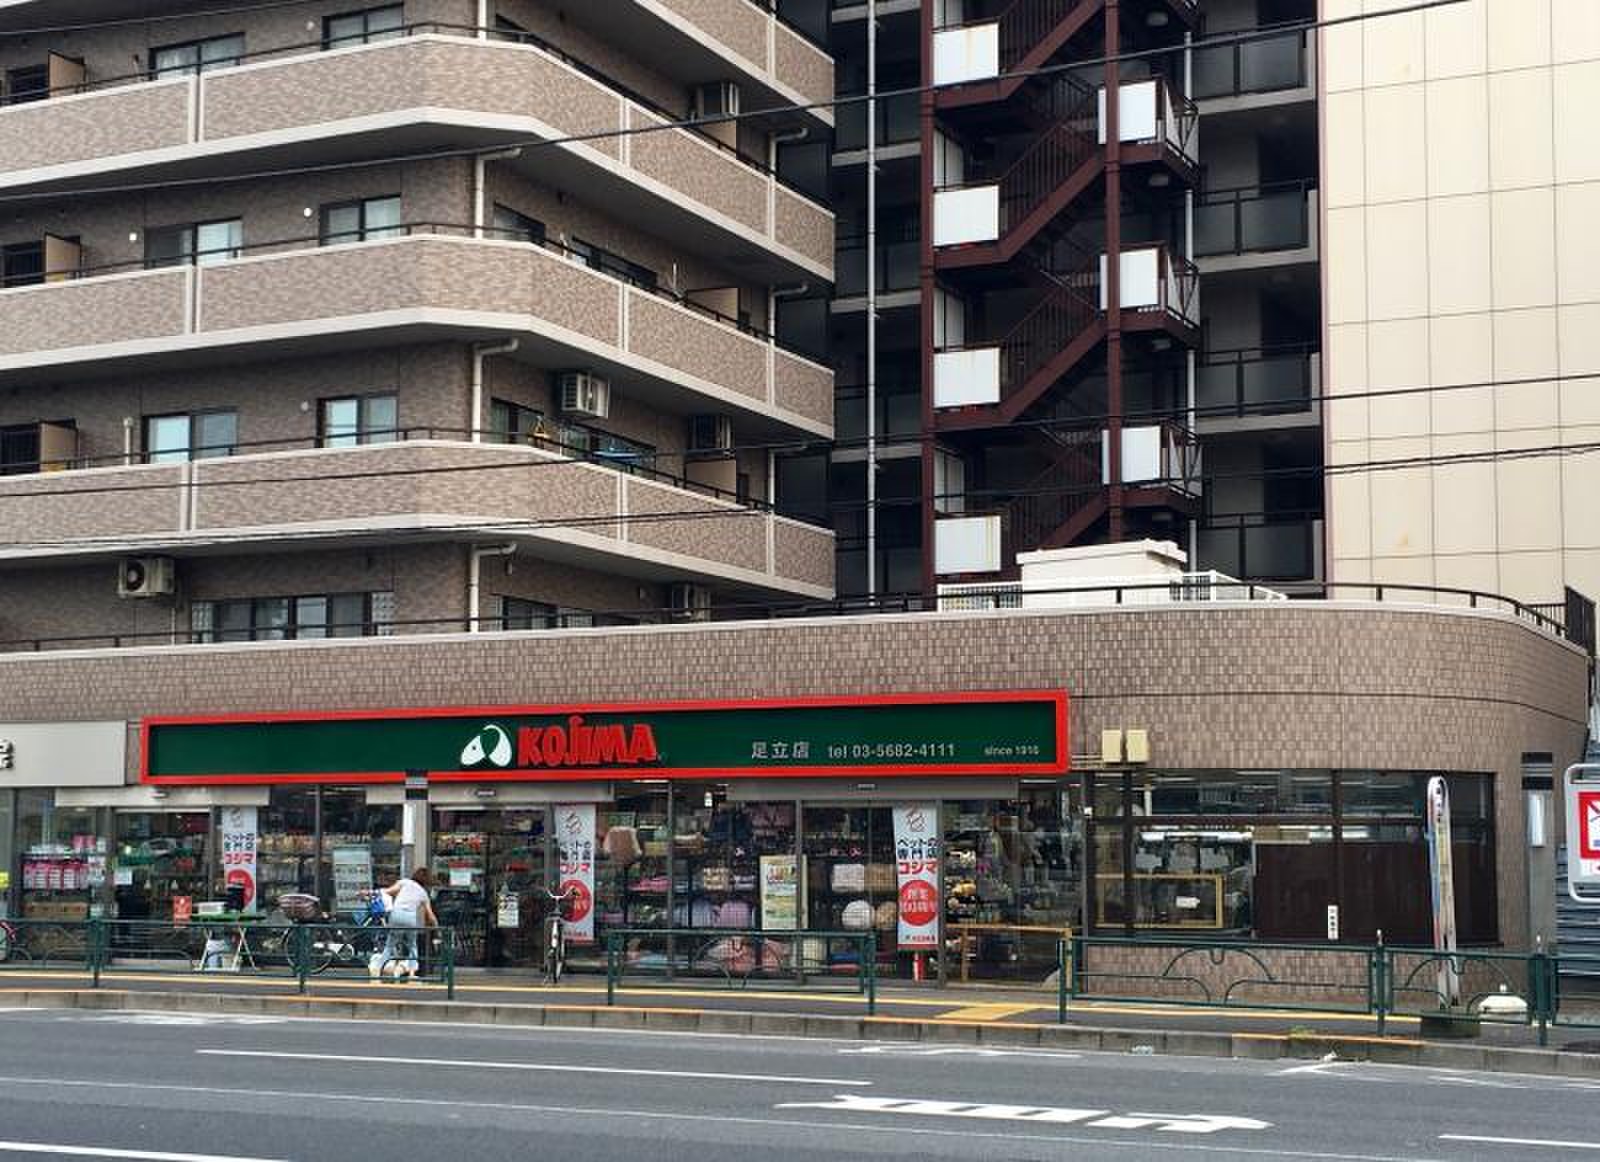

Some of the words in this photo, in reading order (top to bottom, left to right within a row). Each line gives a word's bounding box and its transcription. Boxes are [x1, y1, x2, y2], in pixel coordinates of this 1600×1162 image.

[518, 715, 657, 766] KOJIMA
[752, 741, 809, 759] 足立店
[828, 744, 847, 758] tel
[852, 743, 955, 758] 03-5682-4111
[225, 853, 254, 865] コジマ
[898, 862, 938, 875] コジマ
